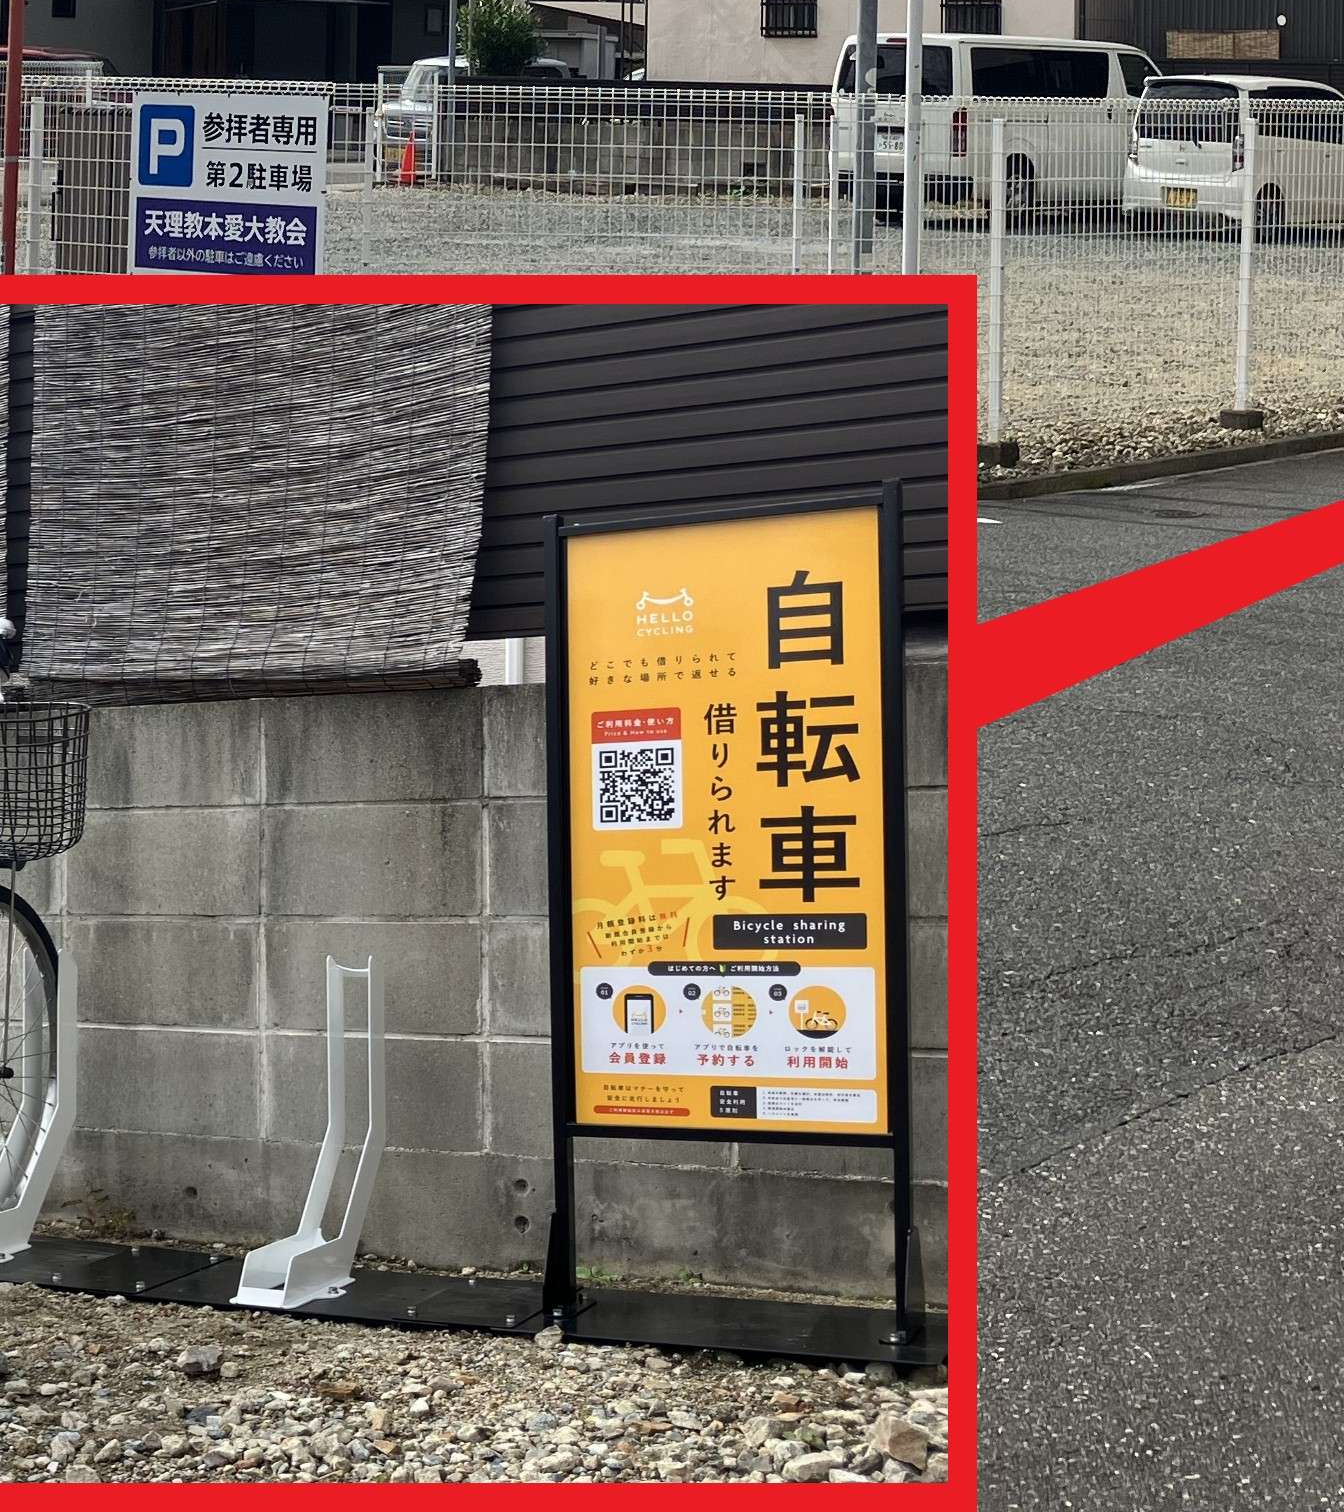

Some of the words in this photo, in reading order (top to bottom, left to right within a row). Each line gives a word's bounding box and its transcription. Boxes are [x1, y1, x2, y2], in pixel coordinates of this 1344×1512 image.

[202, 112, 317, 146] 参拝者専用
[149, 118, 185, 175] P
[206, 161, 312, 193] 第2駐車場
[144, 209, 308, 246] 天理教本愛大教会
[636, 610, 693, 625] HELLO
[636, 625, 694, 637] CYCLING
[589, 651, 737, 670] どこでも借りられて
[588, 668, 737, 686] 好きな場所で返せる
[755, 569, 861, 903] 自転車
[702, 703, 737, 901] 借りられます
[733, 920, 784, 933] Bicycle
[793, 920, 846, 933] sharing
[763, 934, 815, 944] station
[609, 1052, 666, 1065] 会員登録
[697, 1054, 755, 1067] 予約する
[787, 1055, 849, 1070] 利用開始
